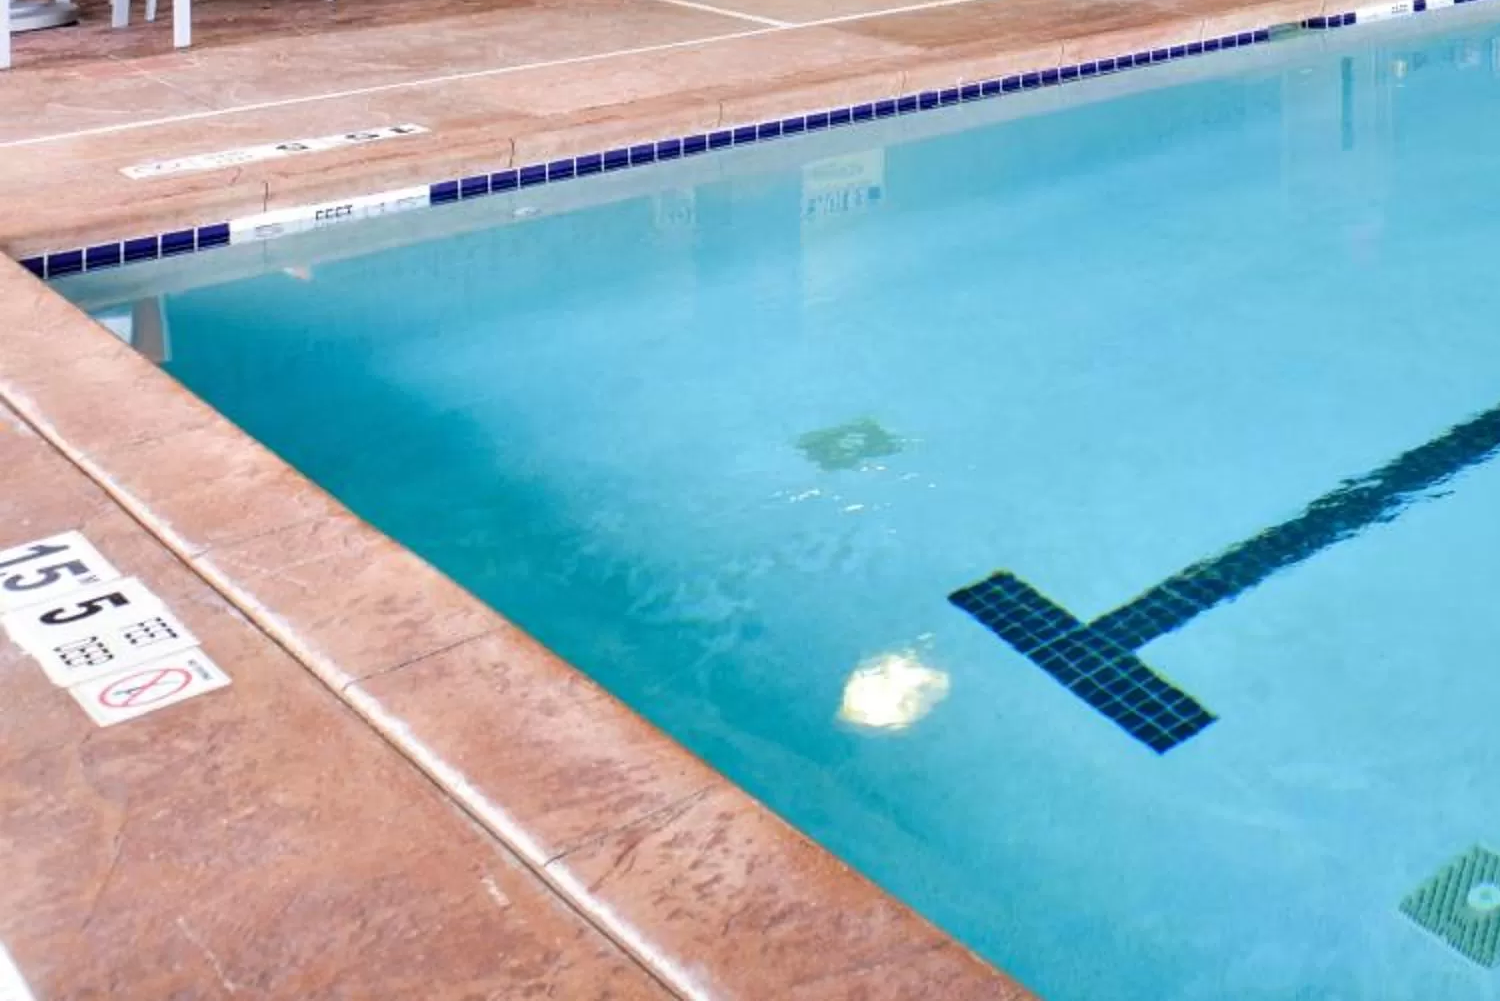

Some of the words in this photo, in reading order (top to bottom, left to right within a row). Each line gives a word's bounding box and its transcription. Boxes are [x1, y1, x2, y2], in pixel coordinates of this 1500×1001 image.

[39, 591, 130, 625] 5
[119, 616, 180, 647] FEET
[53, 635, 116, 667] DEEP
